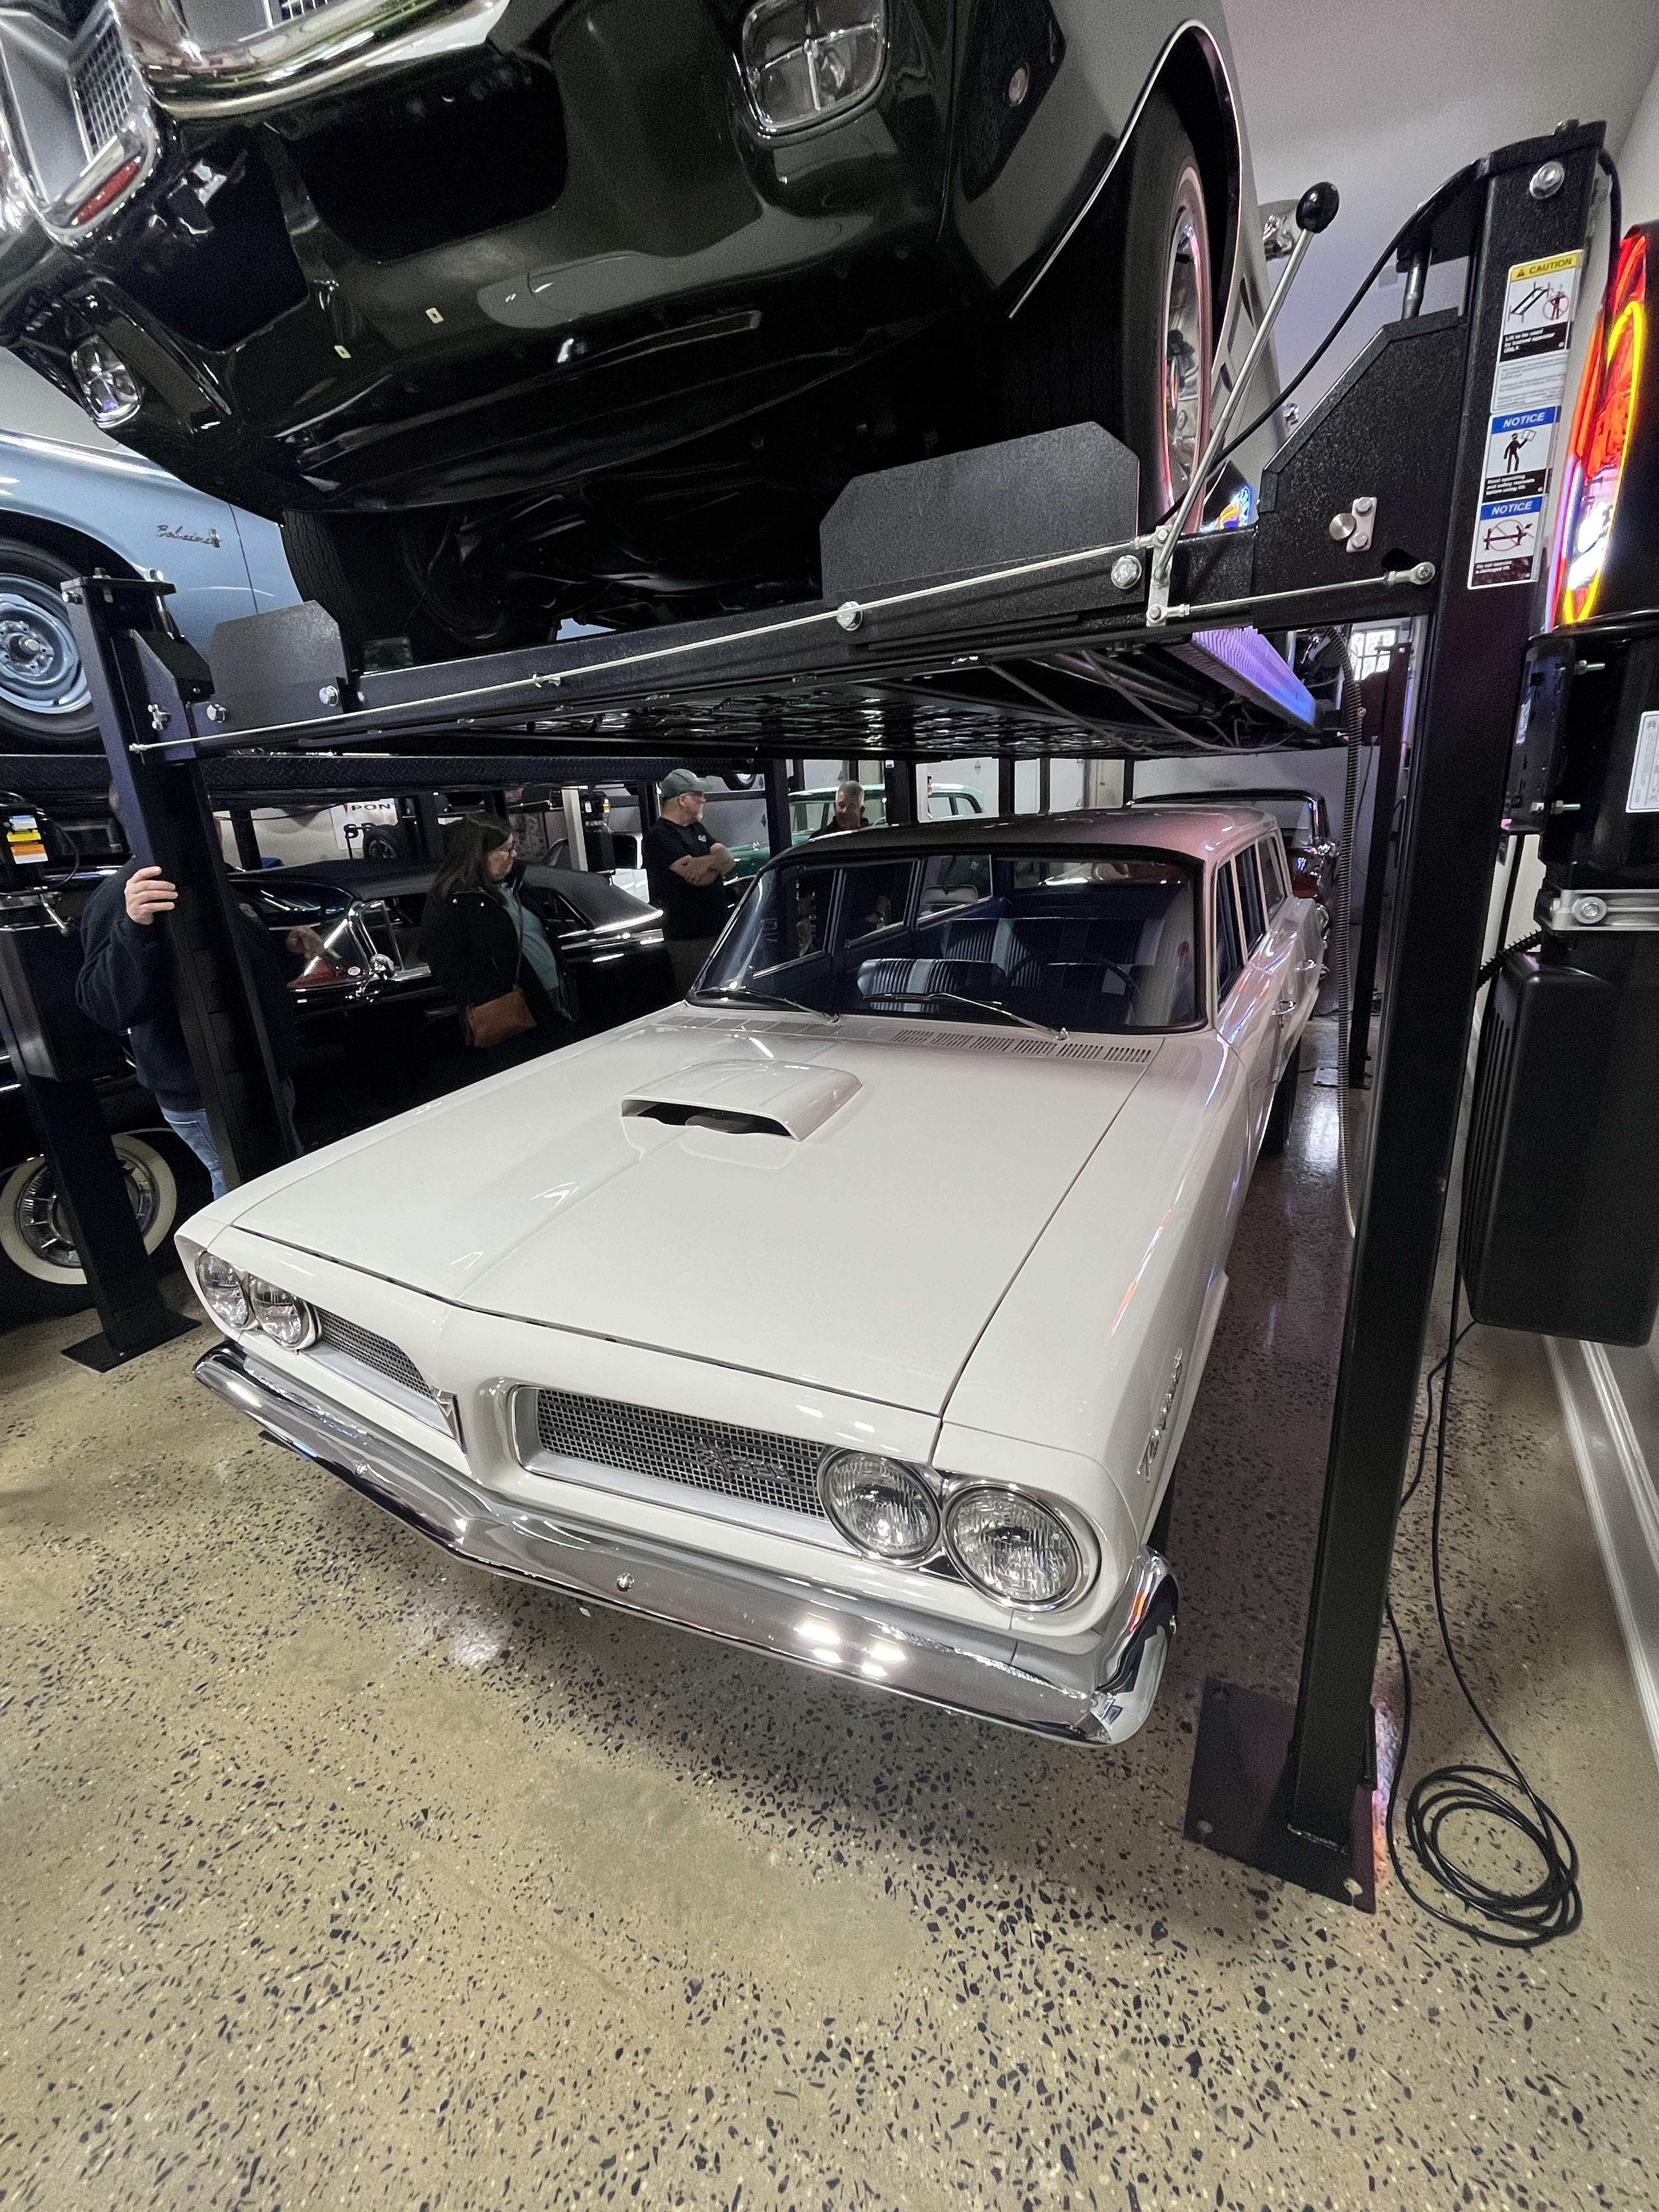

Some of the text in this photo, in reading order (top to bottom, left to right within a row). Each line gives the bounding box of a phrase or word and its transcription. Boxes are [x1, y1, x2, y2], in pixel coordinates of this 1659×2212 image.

[1528, 257, 1573, 274] CAUTION
[1503, 412, 1546, 428] NOTICE
[1491, 500, 1534, 515] NOTICE
